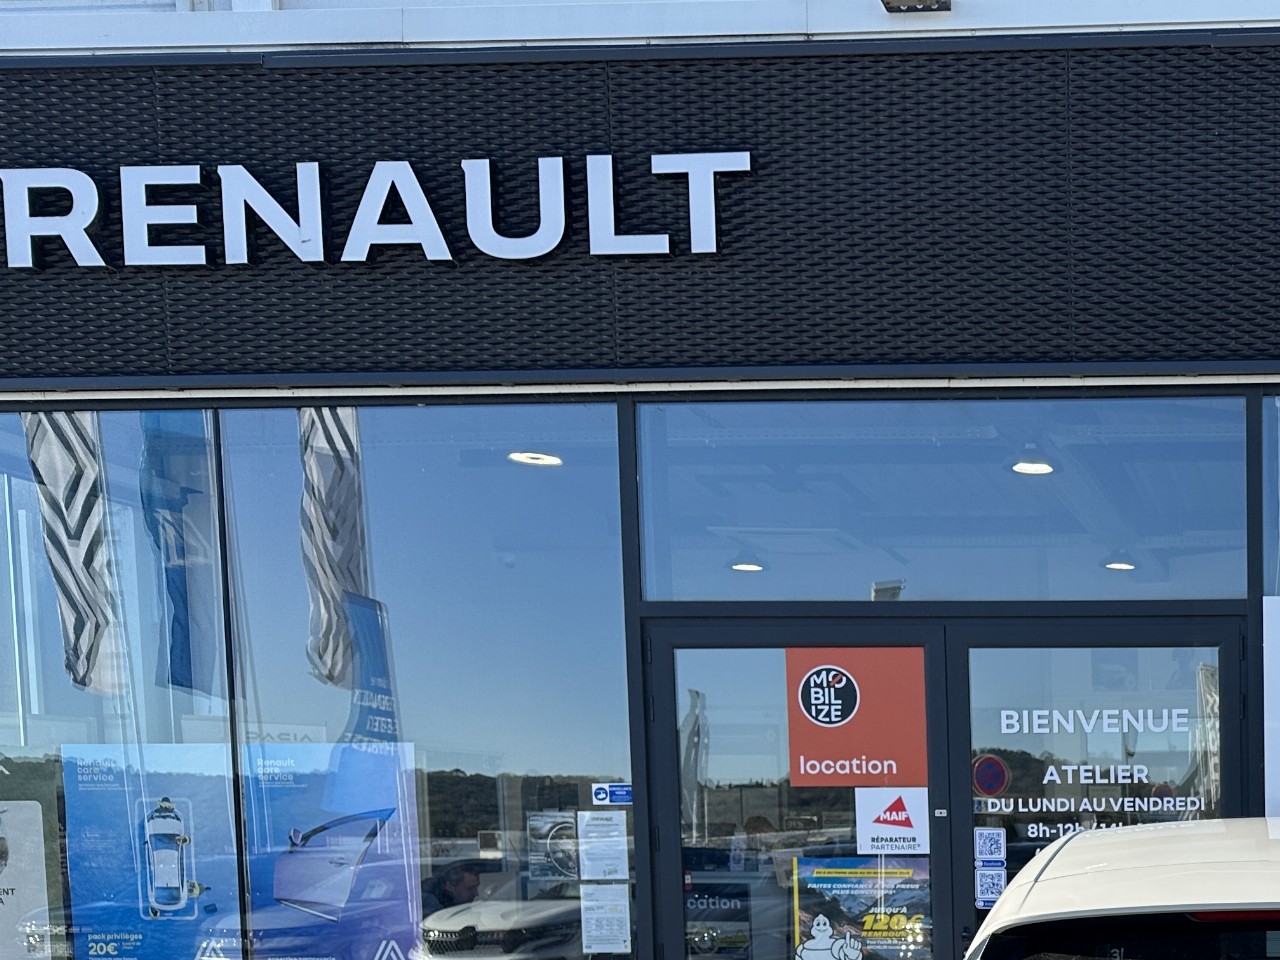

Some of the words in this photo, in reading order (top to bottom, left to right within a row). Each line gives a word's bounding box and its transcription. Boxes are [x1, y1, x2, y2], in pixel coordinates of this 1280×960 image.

[0, 150, 751, 268] RENAULT
[1000, 708, 1190, 734] BIENVENUE
[256, 757, 296, 767] Renault
[799, 755, 898, 775] location
[257, 766, 280, 774] care
[1042, 764, 1149, 785] ATELIER
[77, 772, 115, 781] service
[257, 772, 295, 781] service
[987, 798, 1014, 813] DU
[1018, 798, 1075, 812] LUNDI
[1079, 798, 1107, 812] AU
[1110, 797, 1205, 812] VENDREDI
[879, 811, 909, 821] MAIF
[870, 836, 917, 844] RÉPARATEUR
